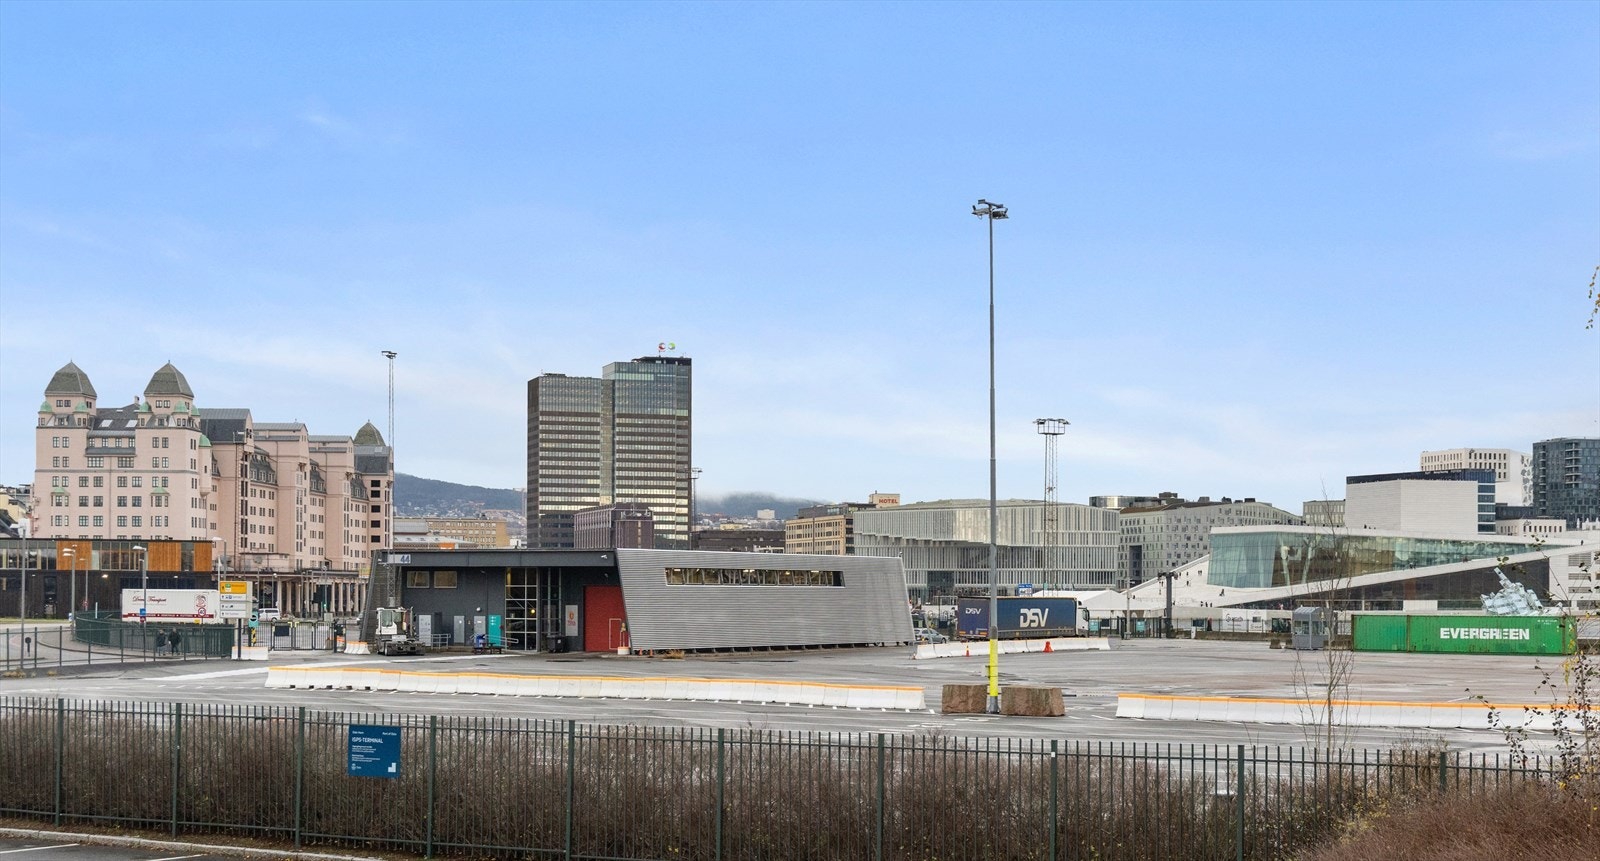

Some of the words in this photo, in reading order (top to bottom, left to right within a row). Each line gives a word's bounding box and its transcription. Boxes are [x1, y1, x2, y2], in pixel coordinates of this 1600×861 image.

[400, 555, 410, 563] 44
[1020, 608, 1049, 627] DSV
[1440, 627, 1530, 640] EVERGREEN
